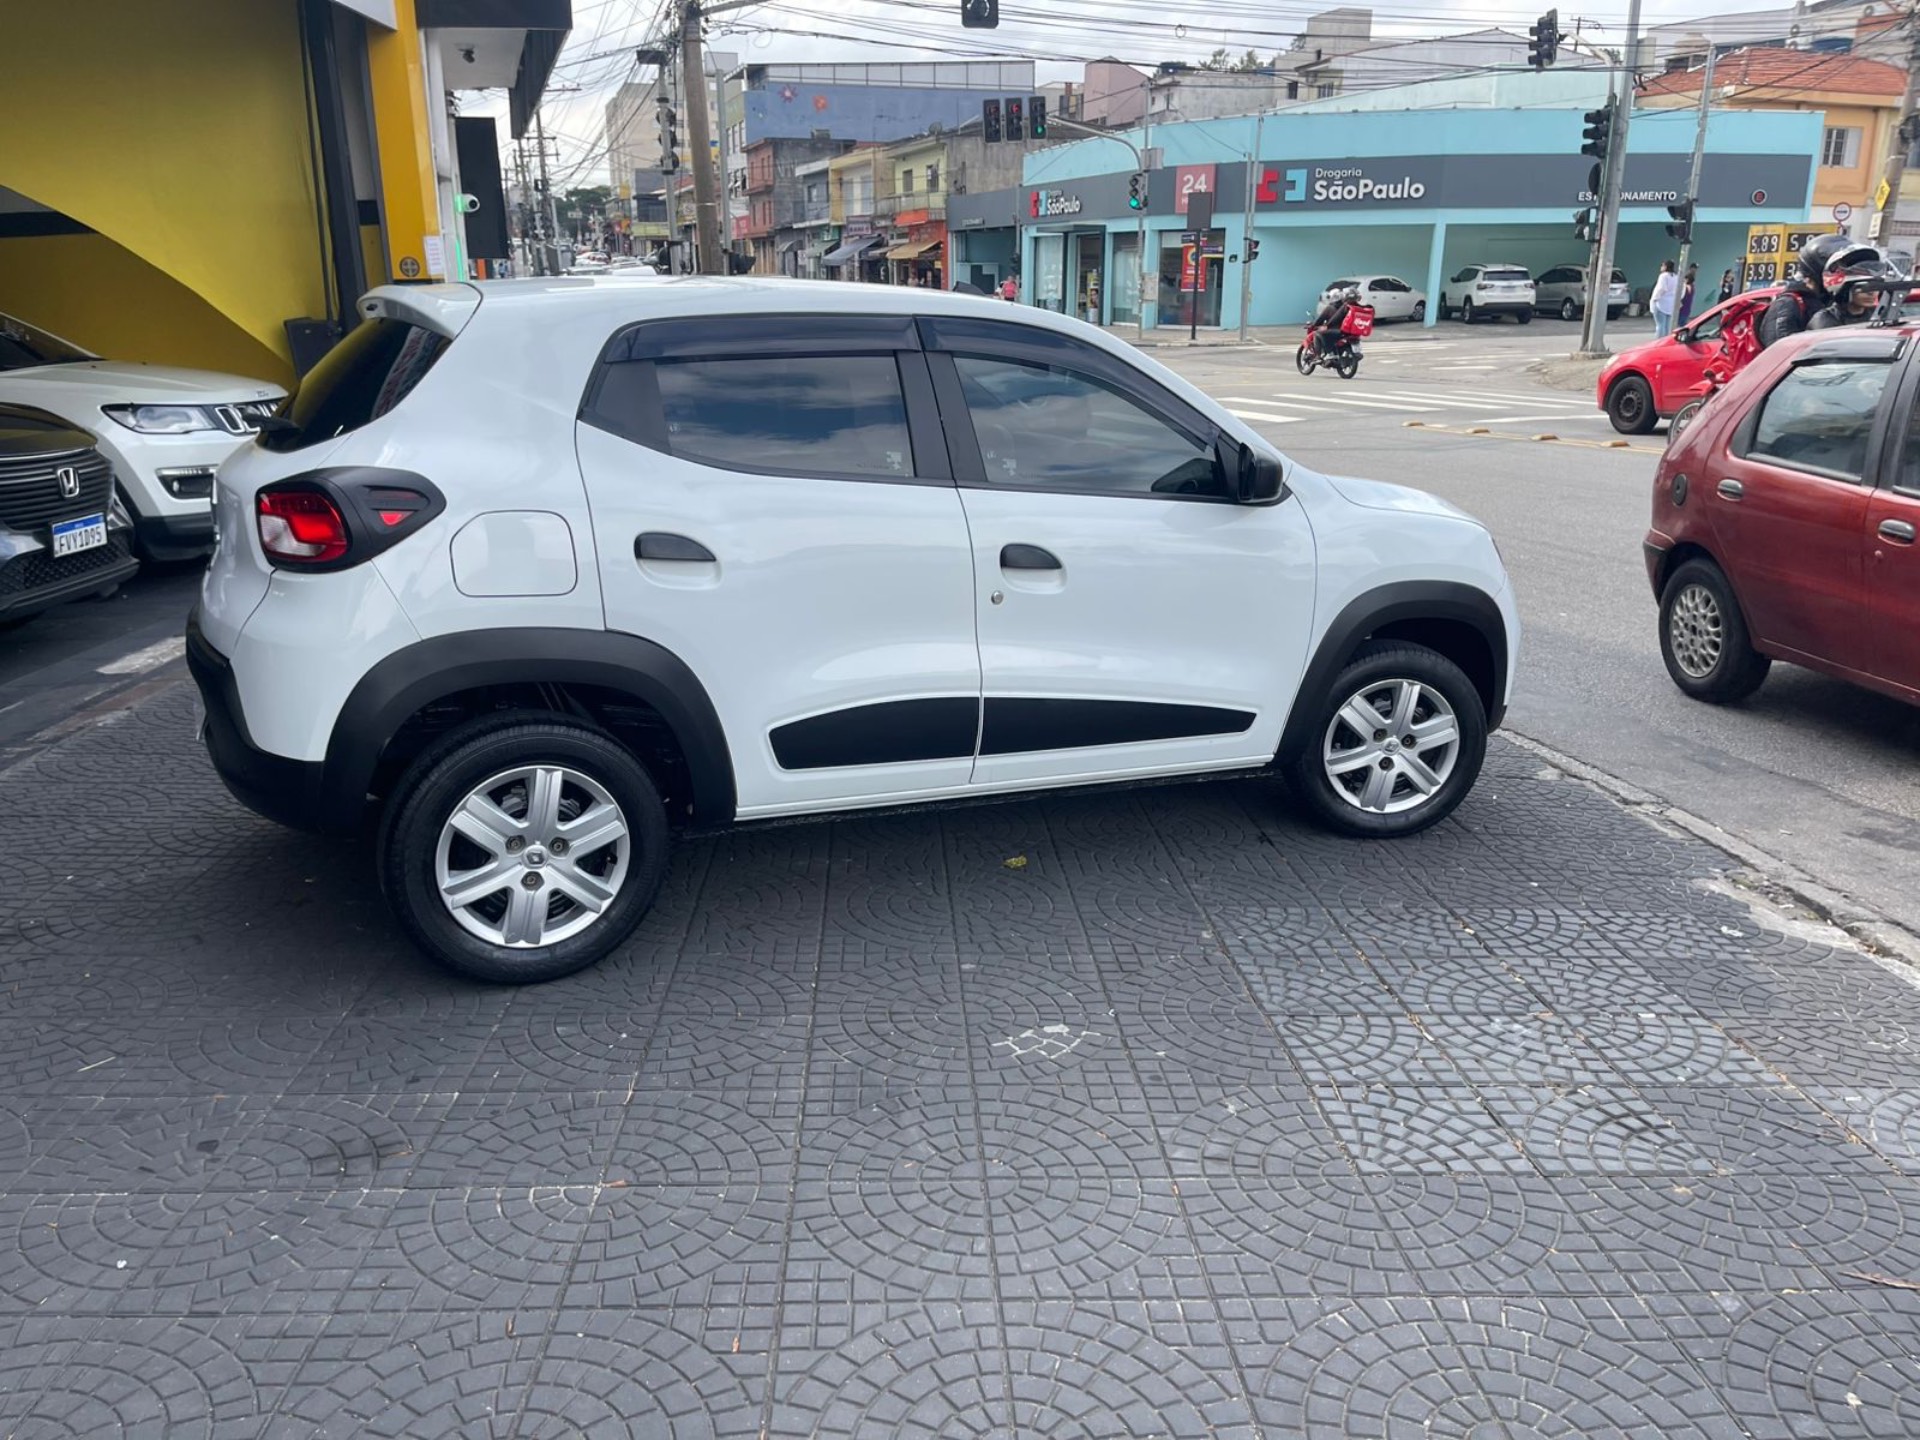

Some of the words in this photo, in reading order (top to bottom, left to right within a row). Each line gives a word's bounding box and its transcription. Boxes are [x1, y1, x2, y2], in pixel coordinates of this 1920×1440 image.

[1182, 173, 1207, 193] 24
[1315, 167, 1363, 180] Drogaria
[1313, 176, 1425, 201] SãoPaulo
[1578, 191, 1678, 201] ESNAMENTO
[60, 526, 102, 553] FVY1D95
